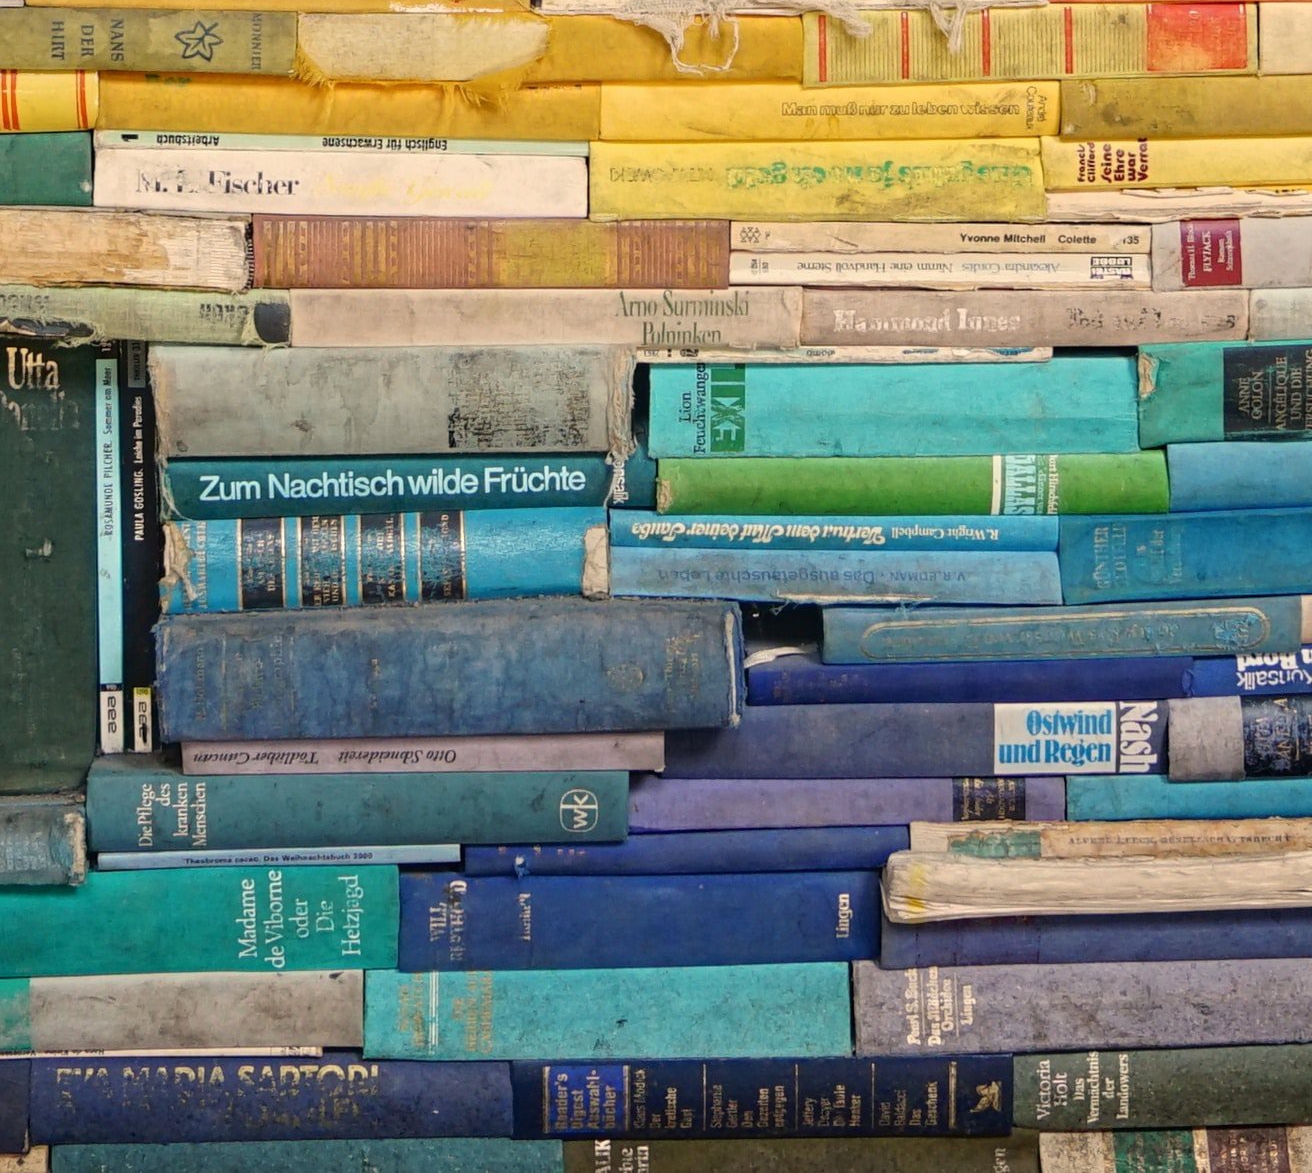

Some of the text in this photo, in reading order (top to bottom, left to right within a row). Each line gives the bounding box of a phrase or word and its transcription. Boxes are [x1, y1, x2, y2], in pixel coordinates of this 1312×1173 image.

[199, 467, 586, 502] Zum Nachtisch wilde Früchte
[1026, 709, 1112, 736] Ostwind
[1119, 702, 1158, 772] Nash
[999, 739, 1112, 768] und Regen
[236, 879, 257, 959] Madame
[263, 870, 285, 968] de Viborne
[288, 898, 309, 938] oder
[315, 900, 334, 931] Die
[338, 875, 364, 955] Hetzjagd
